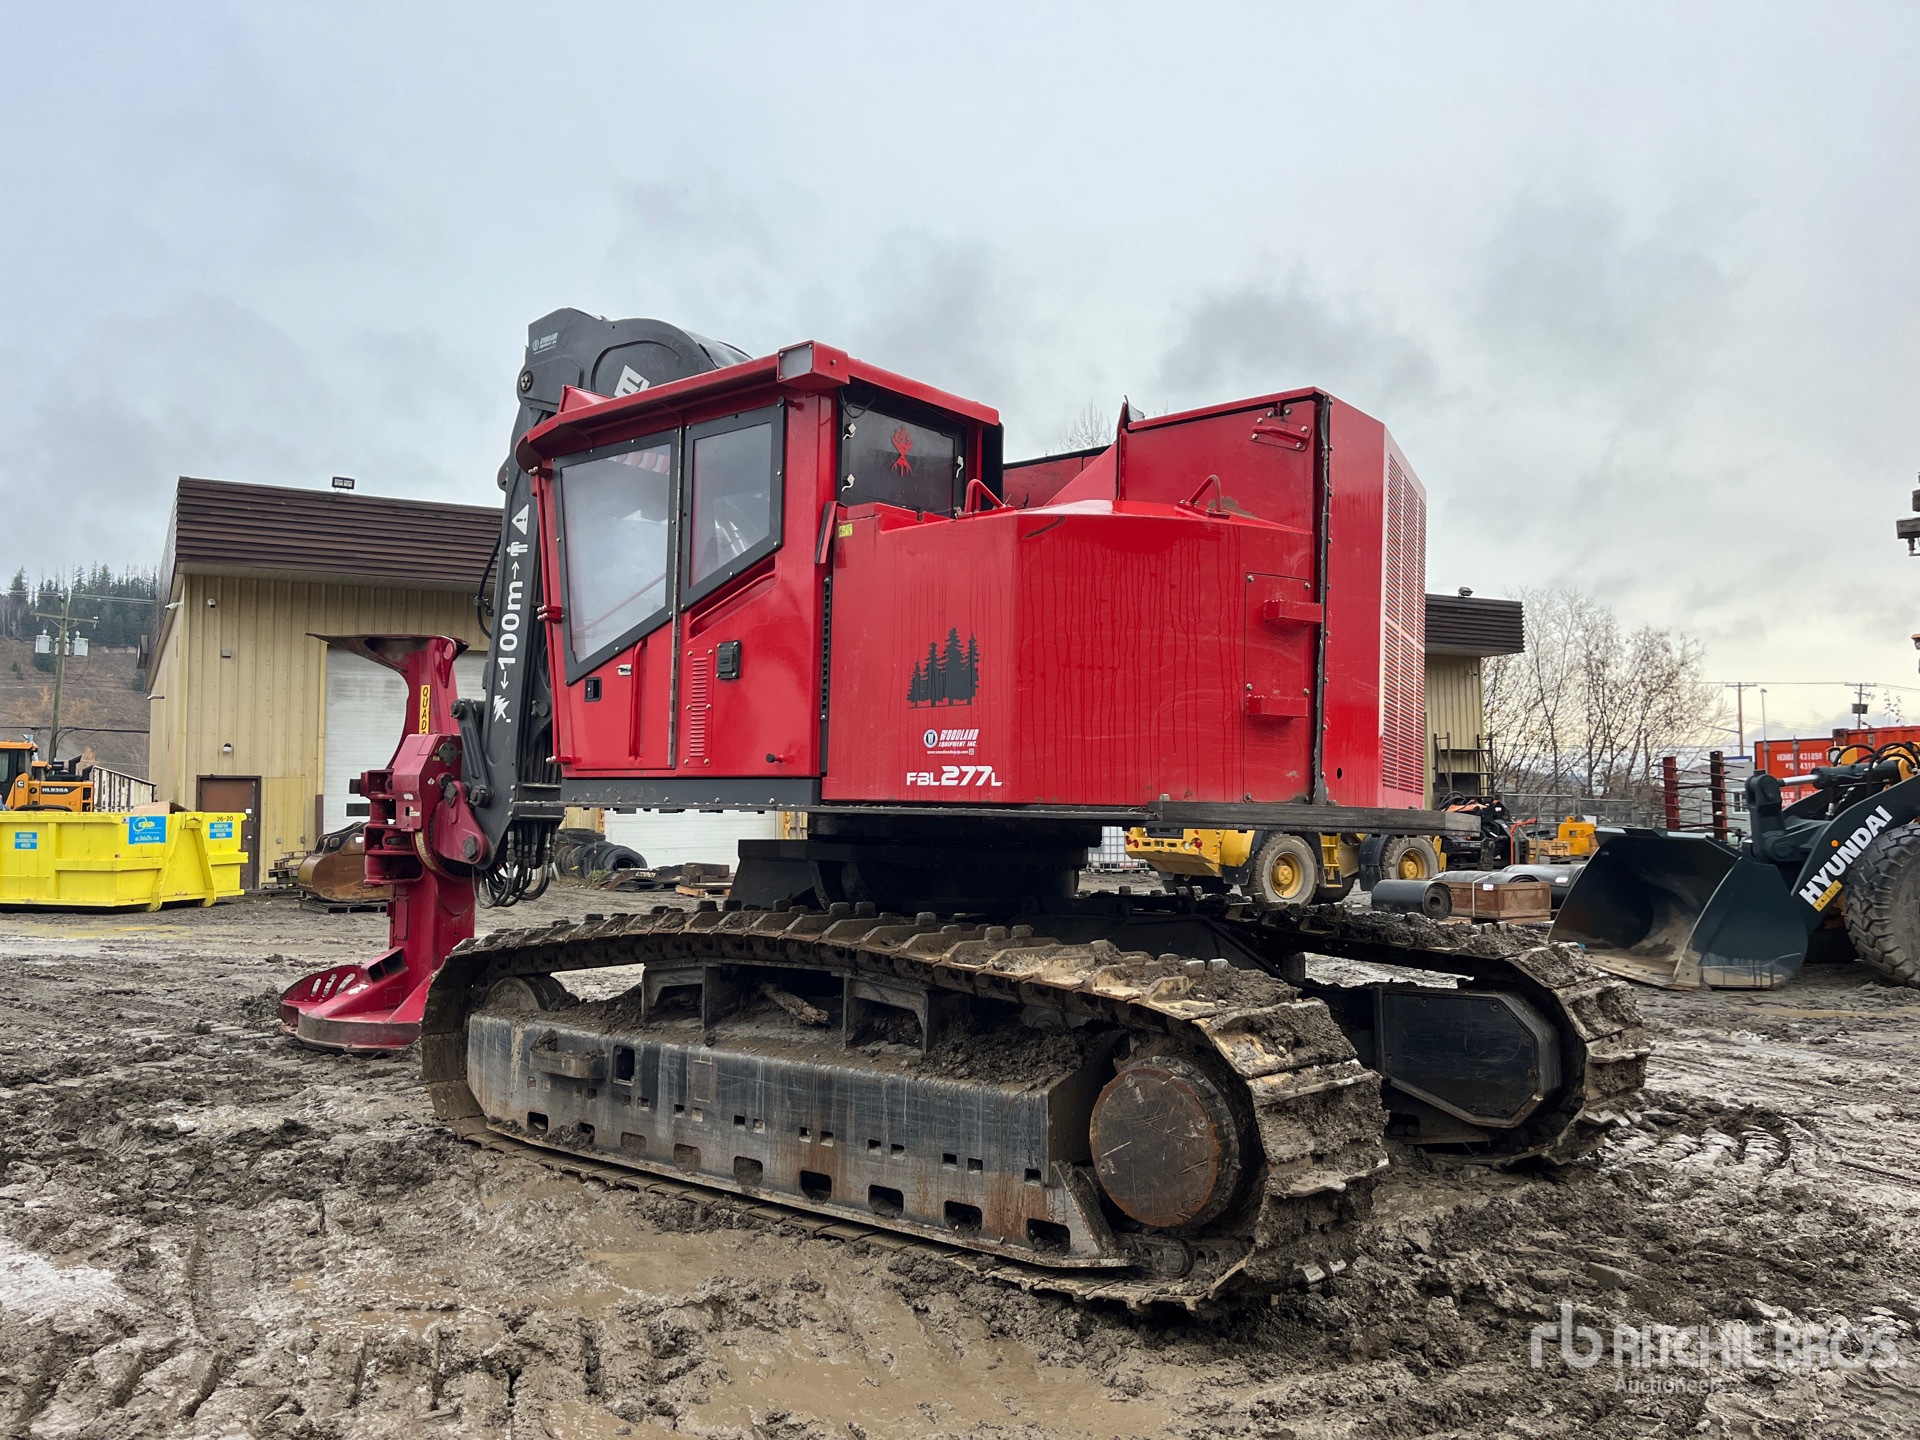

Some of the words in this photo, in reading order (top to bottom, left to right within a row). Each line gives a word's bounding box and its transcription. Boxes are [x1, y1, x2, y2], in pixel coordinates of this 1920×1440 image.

[498, 581, 523, 670] 100m
[421, 686, 429, 734] QUAD
[940, 729, 979, 741] WOODLAND
[906, 765, 1003, 787] FBL277L
[134, 834, 160, 842] e360s.ca
[1799, 805, 1893, 906] HYUNDAI
